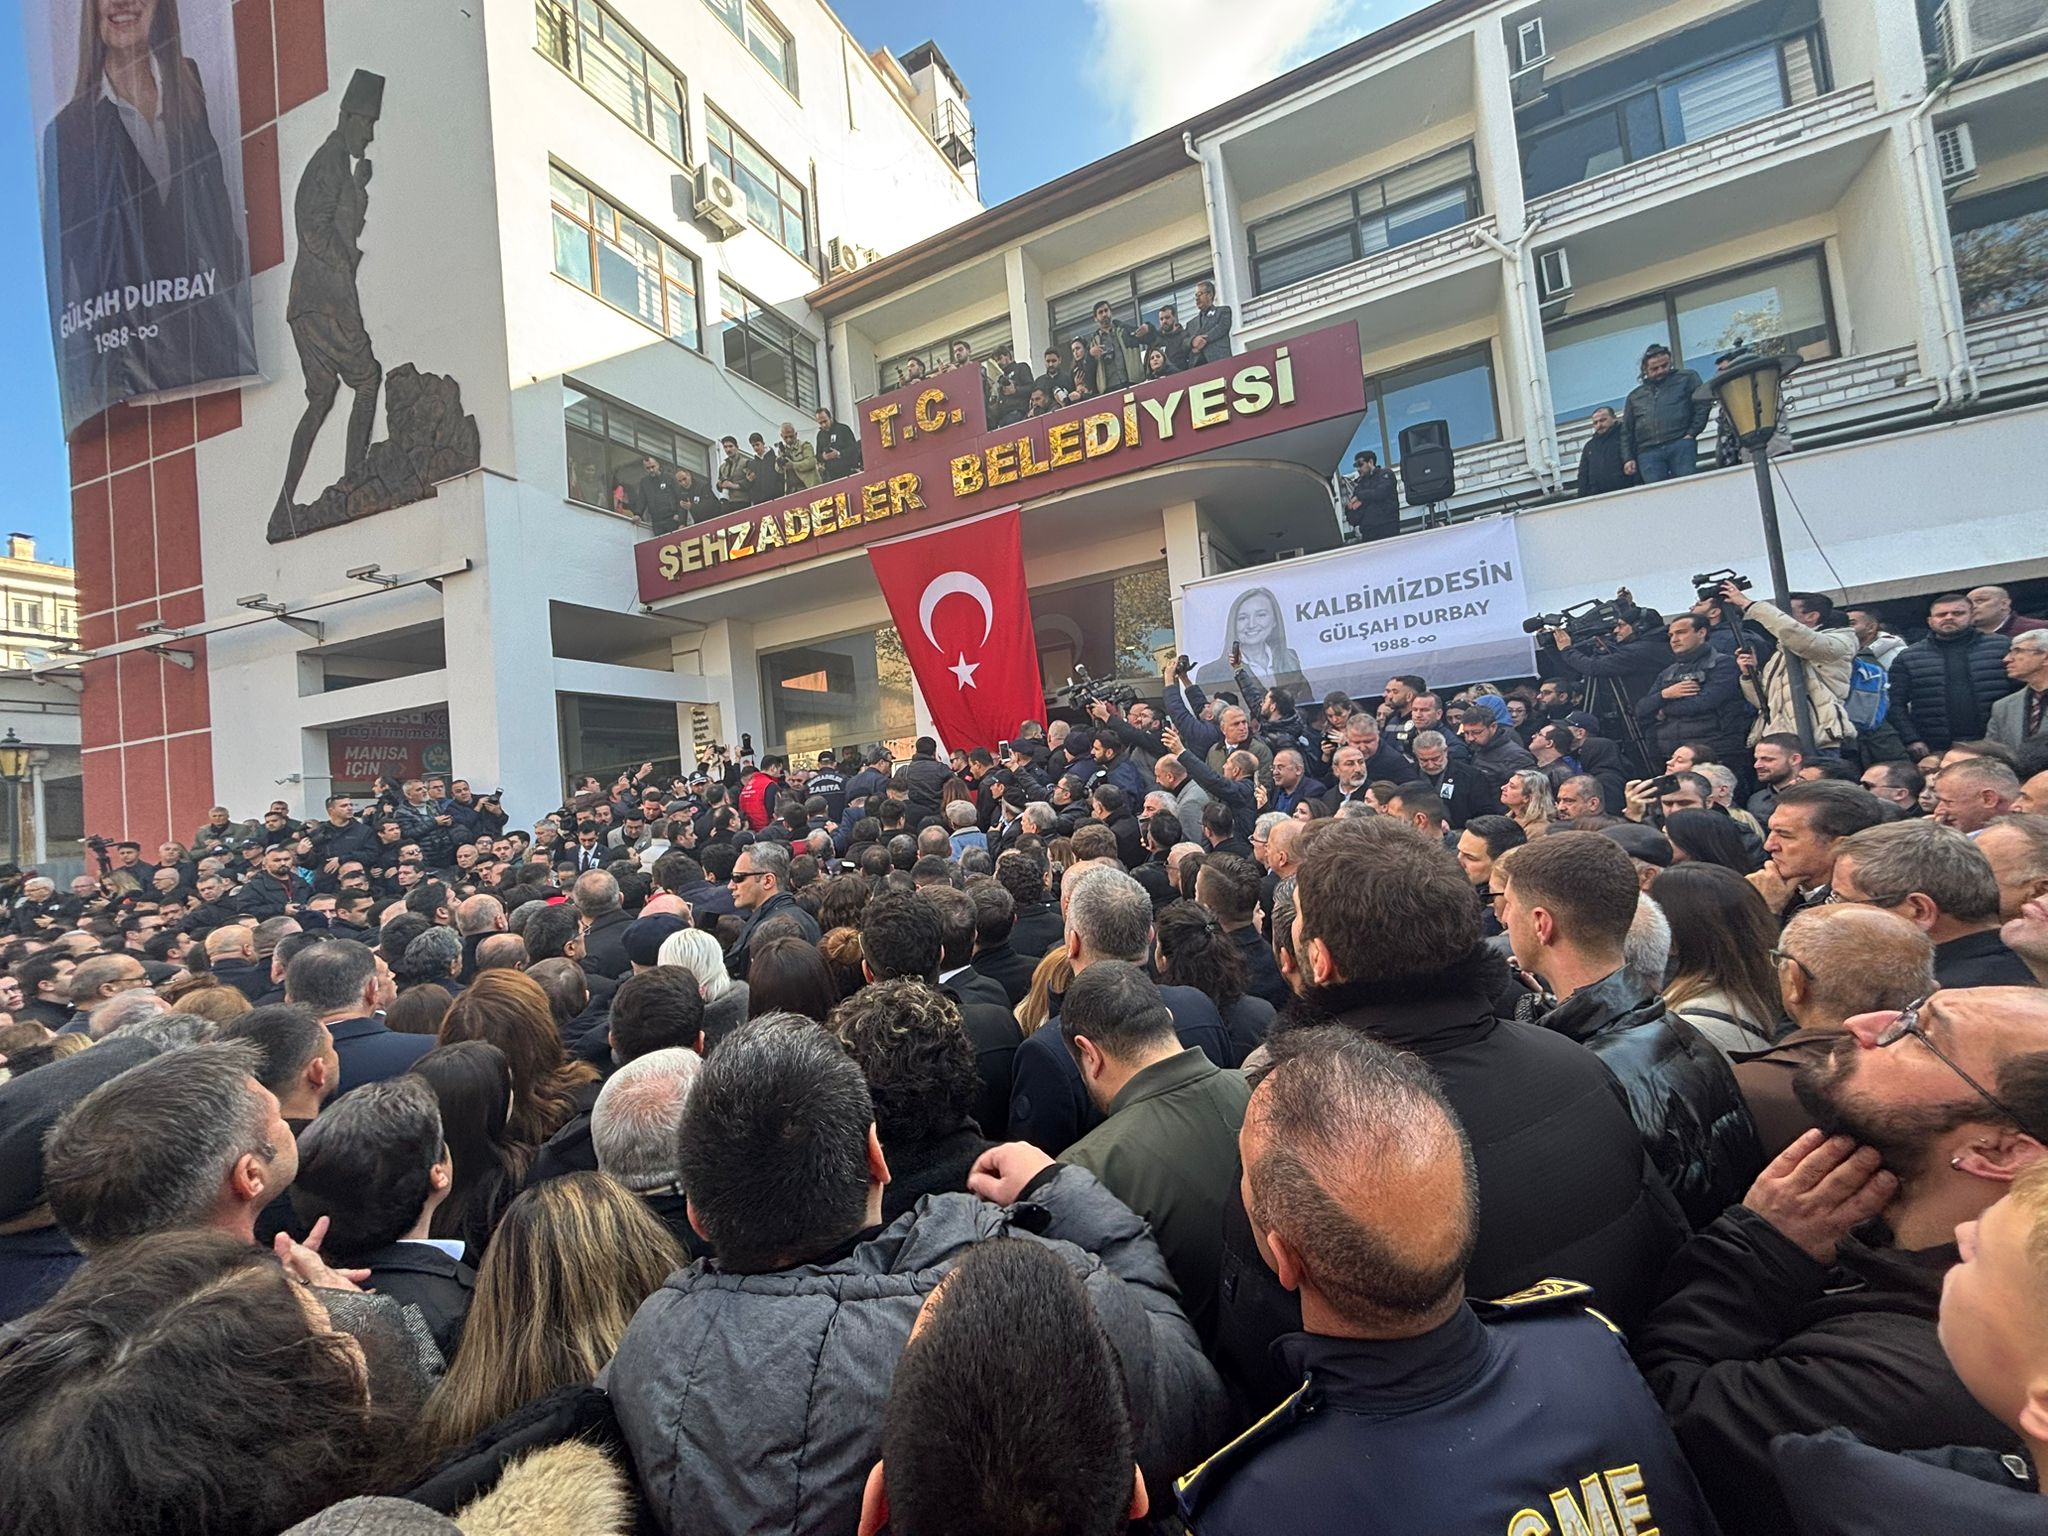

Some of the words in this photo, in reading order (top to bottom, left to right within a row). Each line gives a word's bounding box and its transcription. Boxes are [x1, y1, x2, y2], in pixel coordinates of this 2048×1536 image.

[60, 289, 121, 338] GÜLŞAH
[124, 268, 216, 310] DURBAY
[869, 388, 966, 449] T.C.
[658, 472, 926, 581] ŞEHZADELER
[950, 347, 1297, 498] BELEDİYESİ
[1295, 560, 1512, 622] KALBİMİZDESİN
[1319, 616, 1399, 644] GÜLŞAH
[1404, 599, 1490, 629] DURBAY
[809, 784, 841, 794] ZABITA
